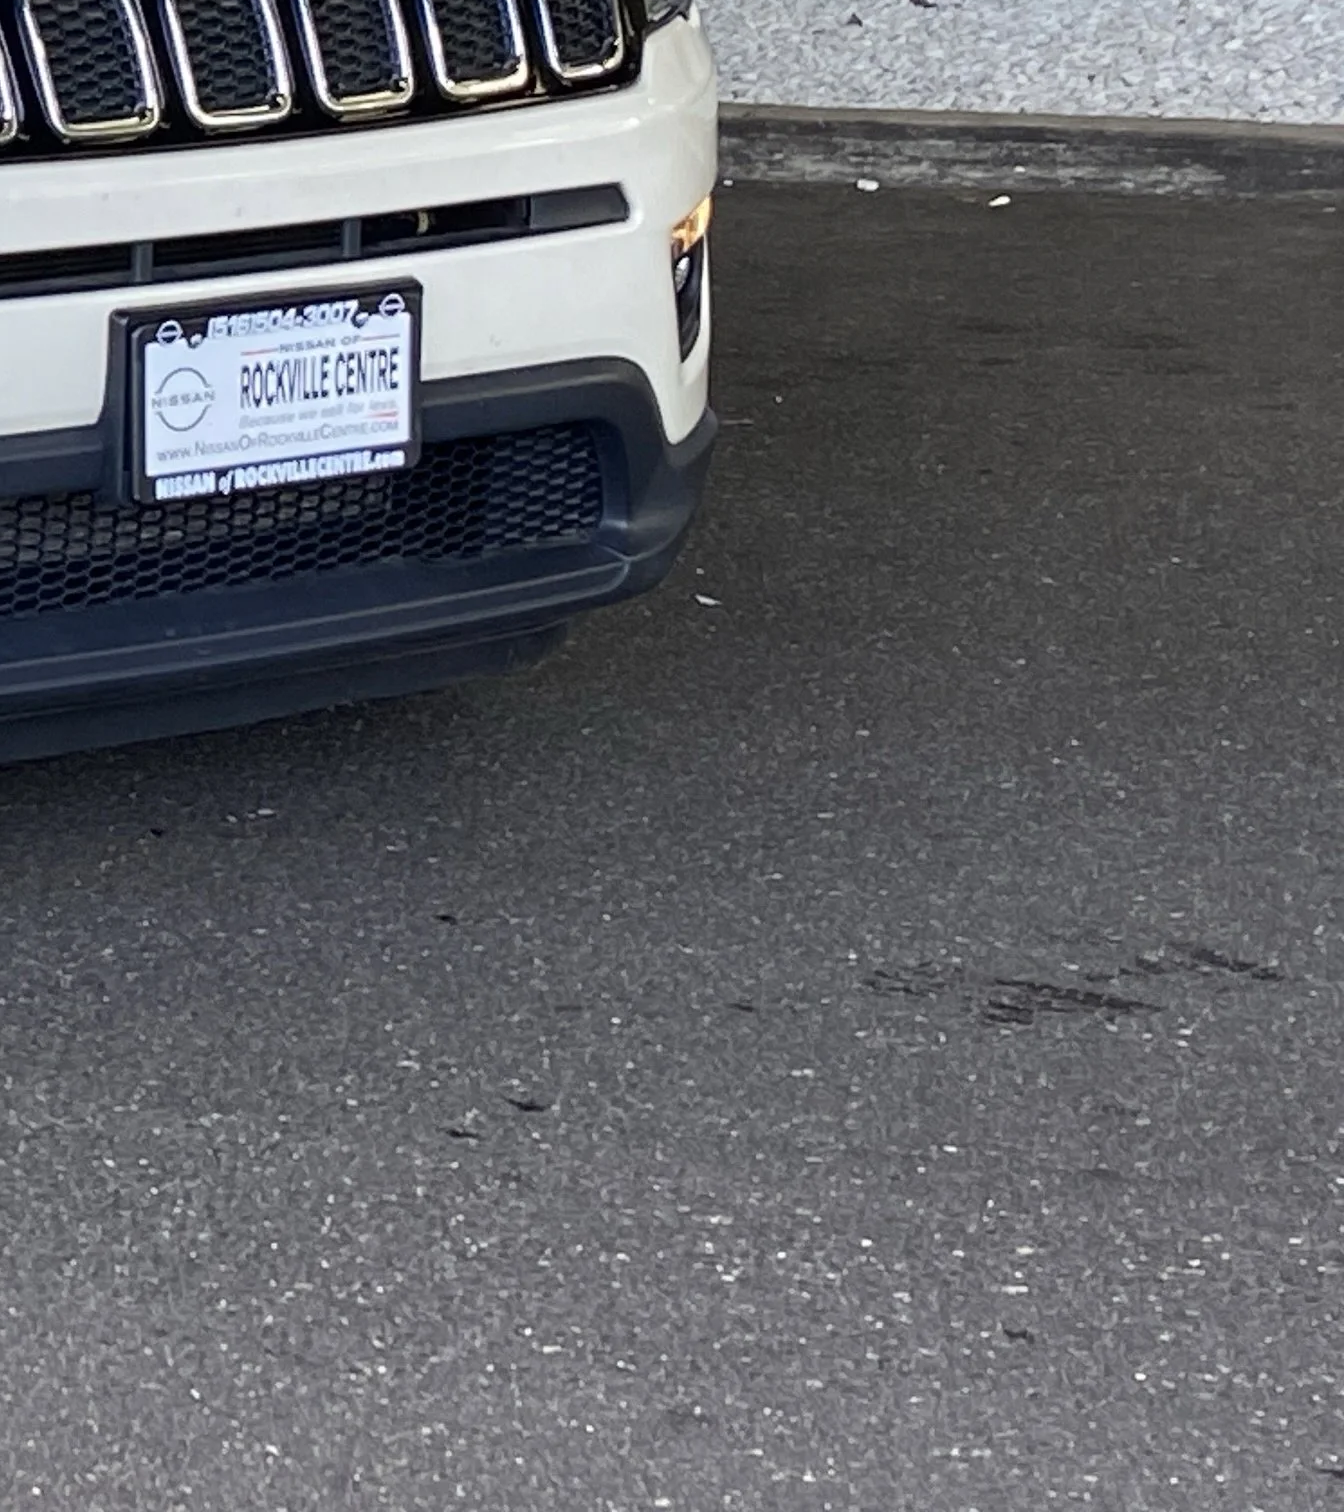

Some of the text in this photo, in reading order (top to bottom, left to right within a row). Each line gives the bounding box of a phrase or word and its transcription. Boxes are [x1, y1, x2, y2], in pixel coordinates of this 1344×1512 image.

[239, 346, 400, 409] ROCKVILLE CENTRE
[151, 390, 216, 409] NISSAN
